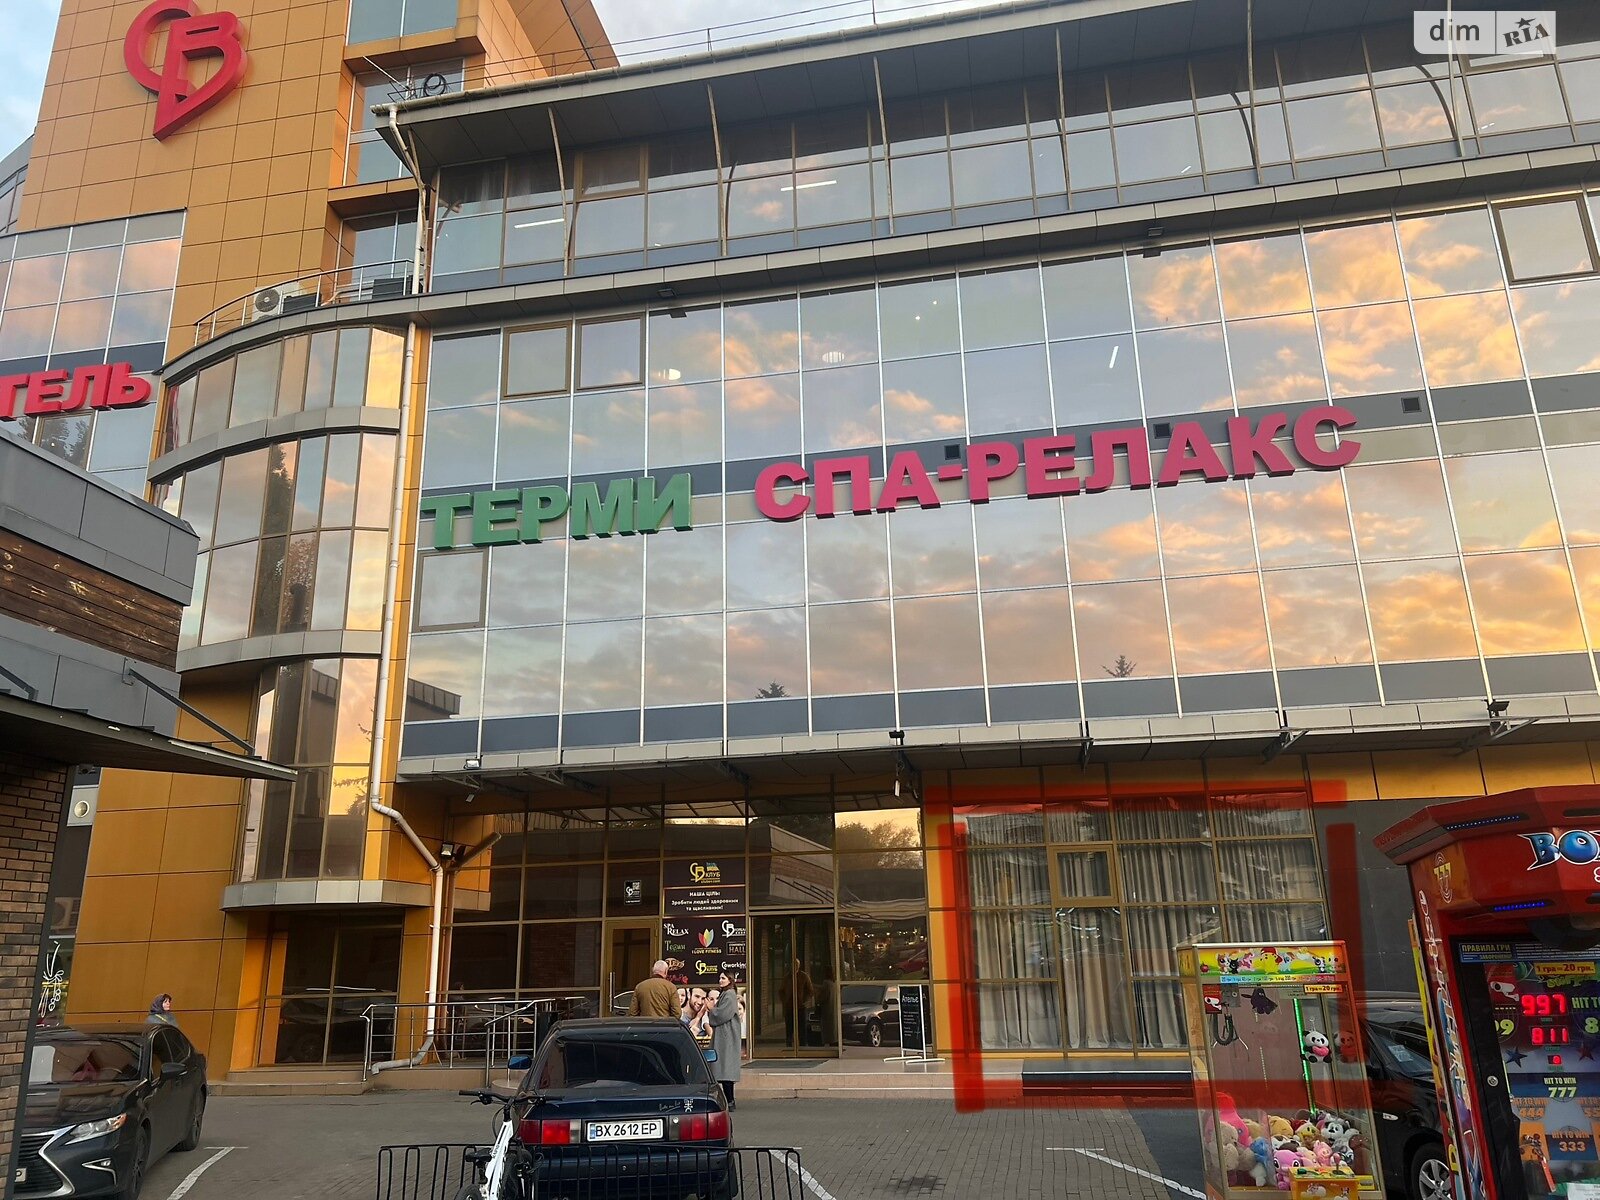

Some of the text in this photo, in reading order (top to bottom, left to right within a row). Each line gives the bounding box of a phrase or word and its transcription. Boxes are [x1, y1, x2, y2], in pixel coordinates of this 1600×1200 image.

[420, 405, 1362, 550] ТЕРМИ СПА-РЕЛАКС
[1517, 829, 1600, 871] BO
[1461, 944, 1496, 952] ПРАВИЛА
[1563, 963, 1576, 972] 20
[1521, 994, 1567, 1016] 997
[1571, 996, 1600, 1008] HIT T
[1531, 1027, 1569, 1044] 811
[1544, 1077, 1554, 1085] HIT
[1554, 1077, 1563, 1085] TO
[1548, 1087, 1577, 1098] 777
[595, 1123, 657, 1137] BX 2612 EP
[1552, 1130, 1590, 1139] HIT TO WIN
[1559, 1141, 1586, 1152] 333
